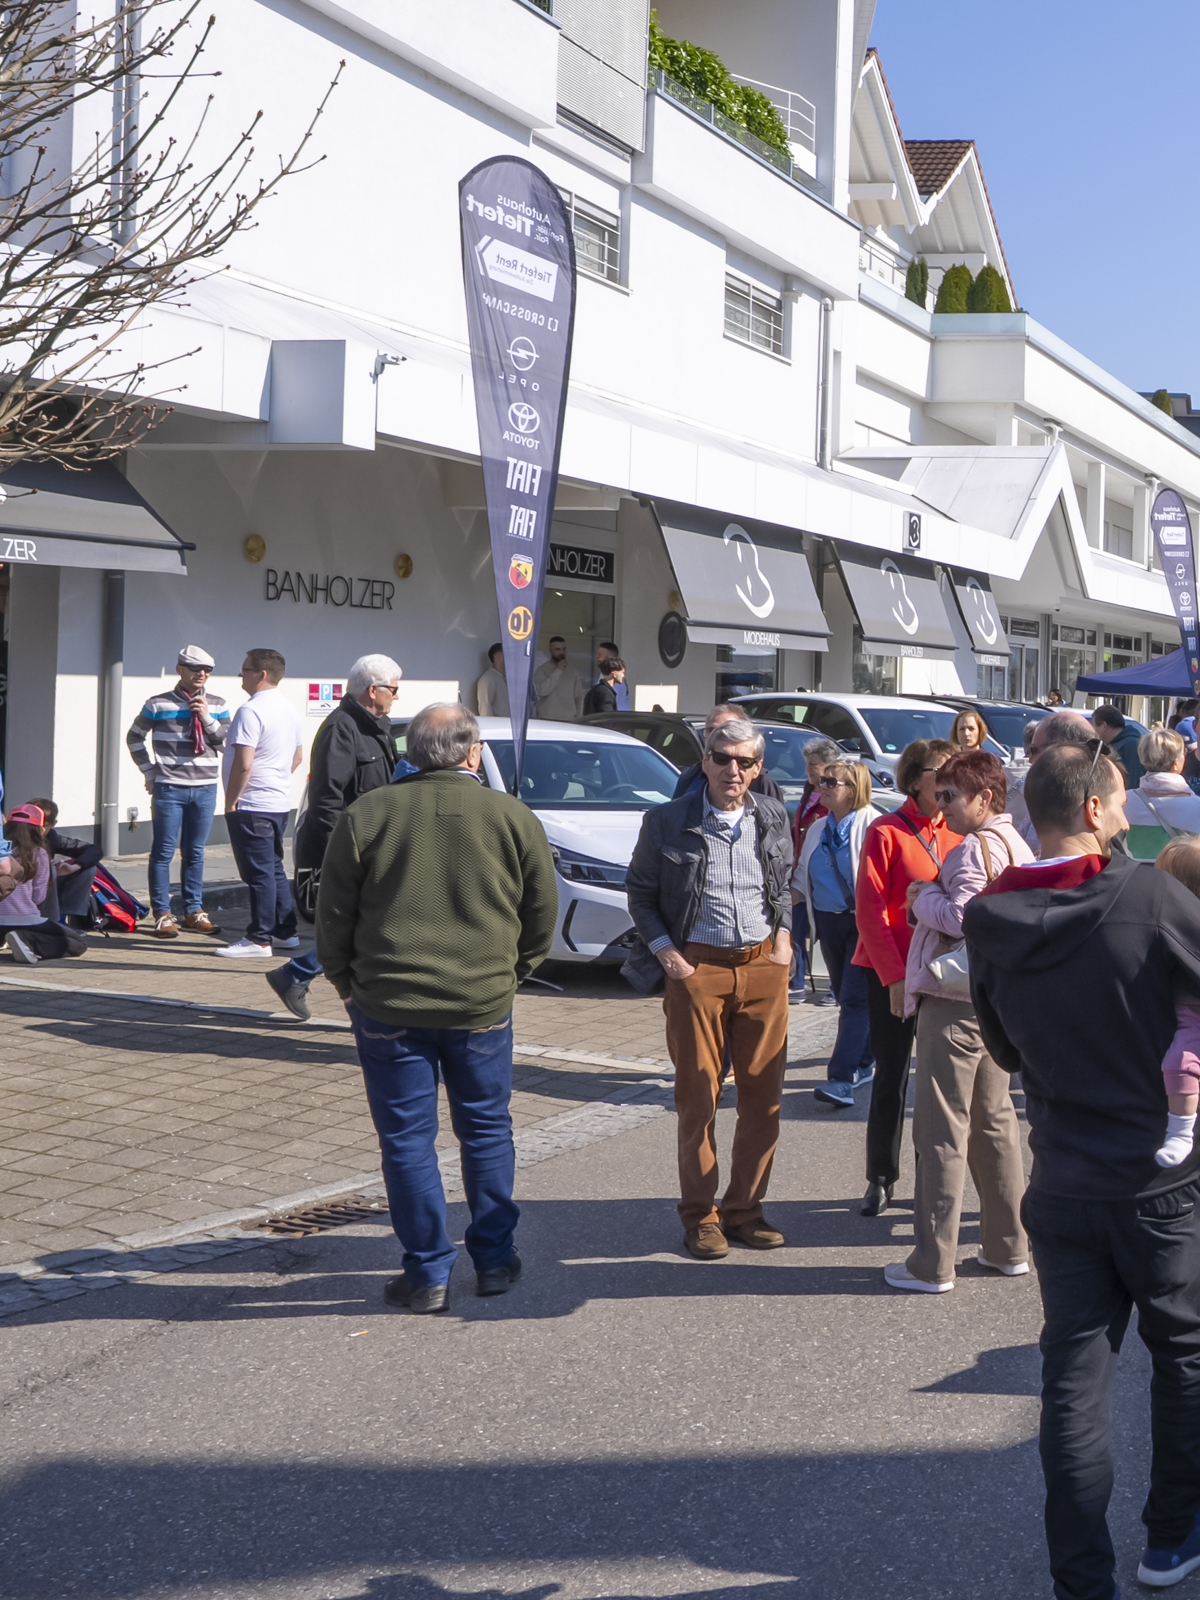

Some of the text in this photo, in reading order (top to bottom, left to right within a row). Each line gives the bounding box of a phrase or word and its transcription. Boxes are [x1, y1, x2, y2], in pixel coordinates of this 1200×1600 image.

[0, 538, 37, 561] ZER
[548, 547, 606, 578] NHOLZER
[266, 568, 396, 610] BANHOLZER
[743, 631, 781, 646] MODEHAUS
[323, 685, 330, 700] P
